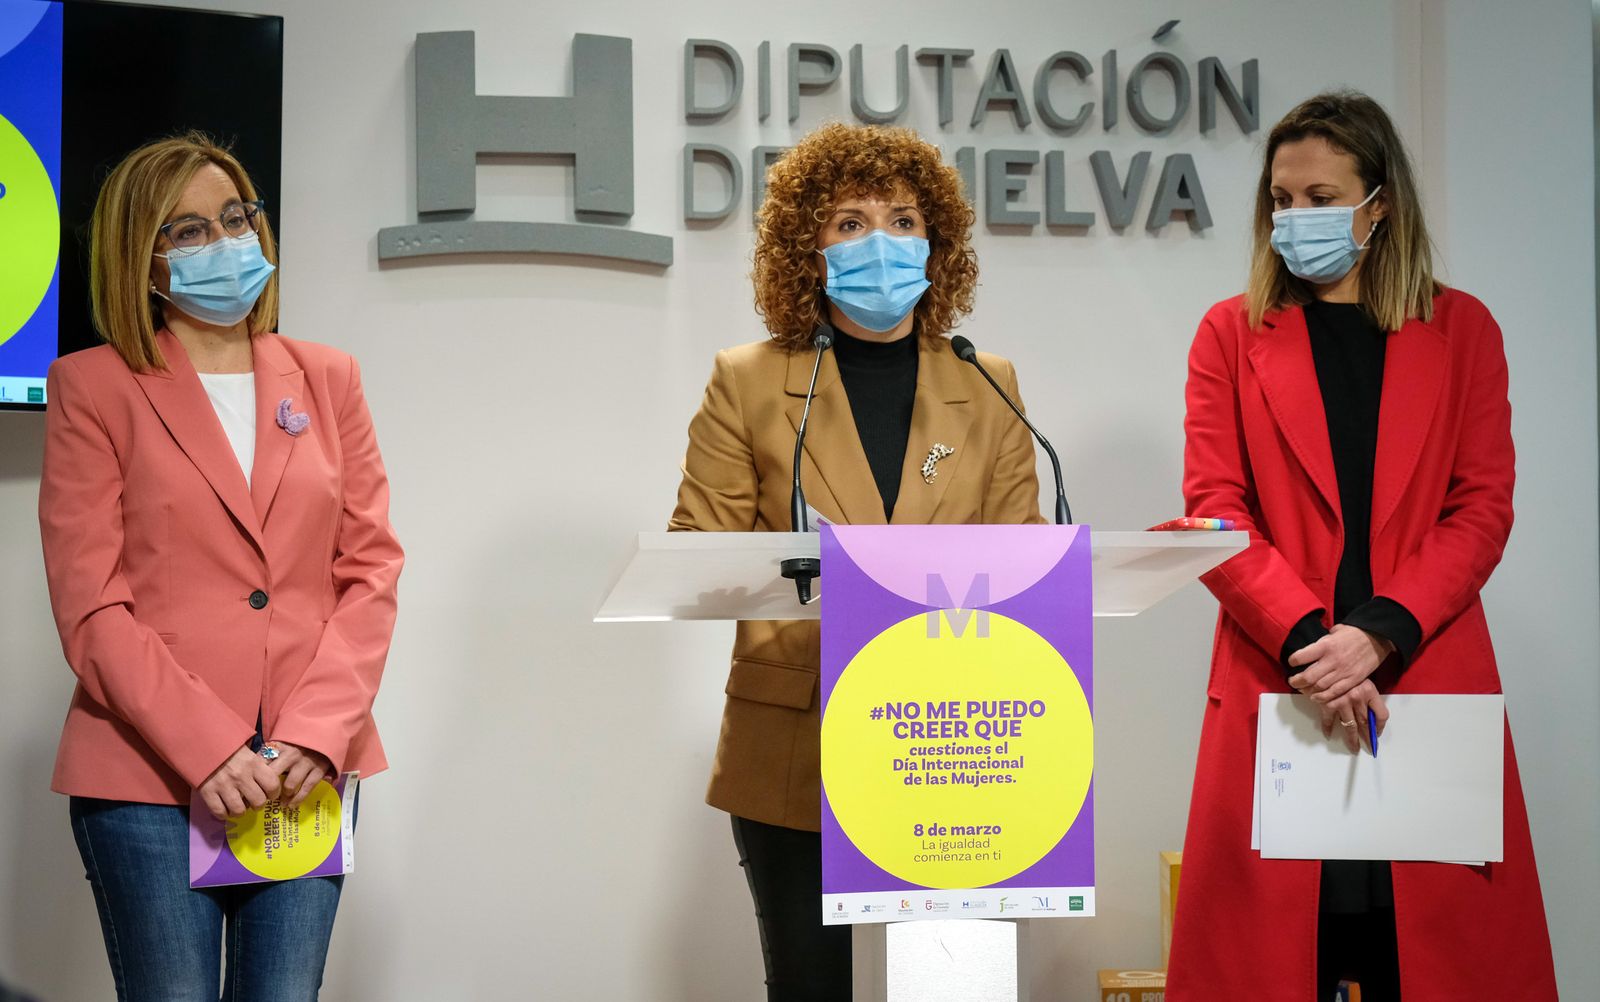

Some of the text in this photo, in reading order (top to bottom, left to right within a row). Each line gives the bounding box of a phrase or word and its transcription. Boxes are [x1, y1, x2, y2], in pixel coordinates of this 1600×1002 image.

[684, 19, 1260, 136] DIPUTACIÓN
[926, 573, 990, 638] M
[870, 700, 1046, 720] #NO ME PUEDO
[893, 720, 1023, 741] CREER QUE
[909, 741, 1008, 756] cuestiones el
[893, 756, 1024, 771] Día Internacional
[904, 771, 1018, 787] de las Mujeres.
[263, 800, 272, 819] PUE
[263, 821, 272, 836] ME
[271, 817, 280, 849] CREER
[913, 822, 1002, 836] 8 de marzo
[922, 838, 991, 852] La igualdad
[913, 849, 1002, 862] comienza en ti
